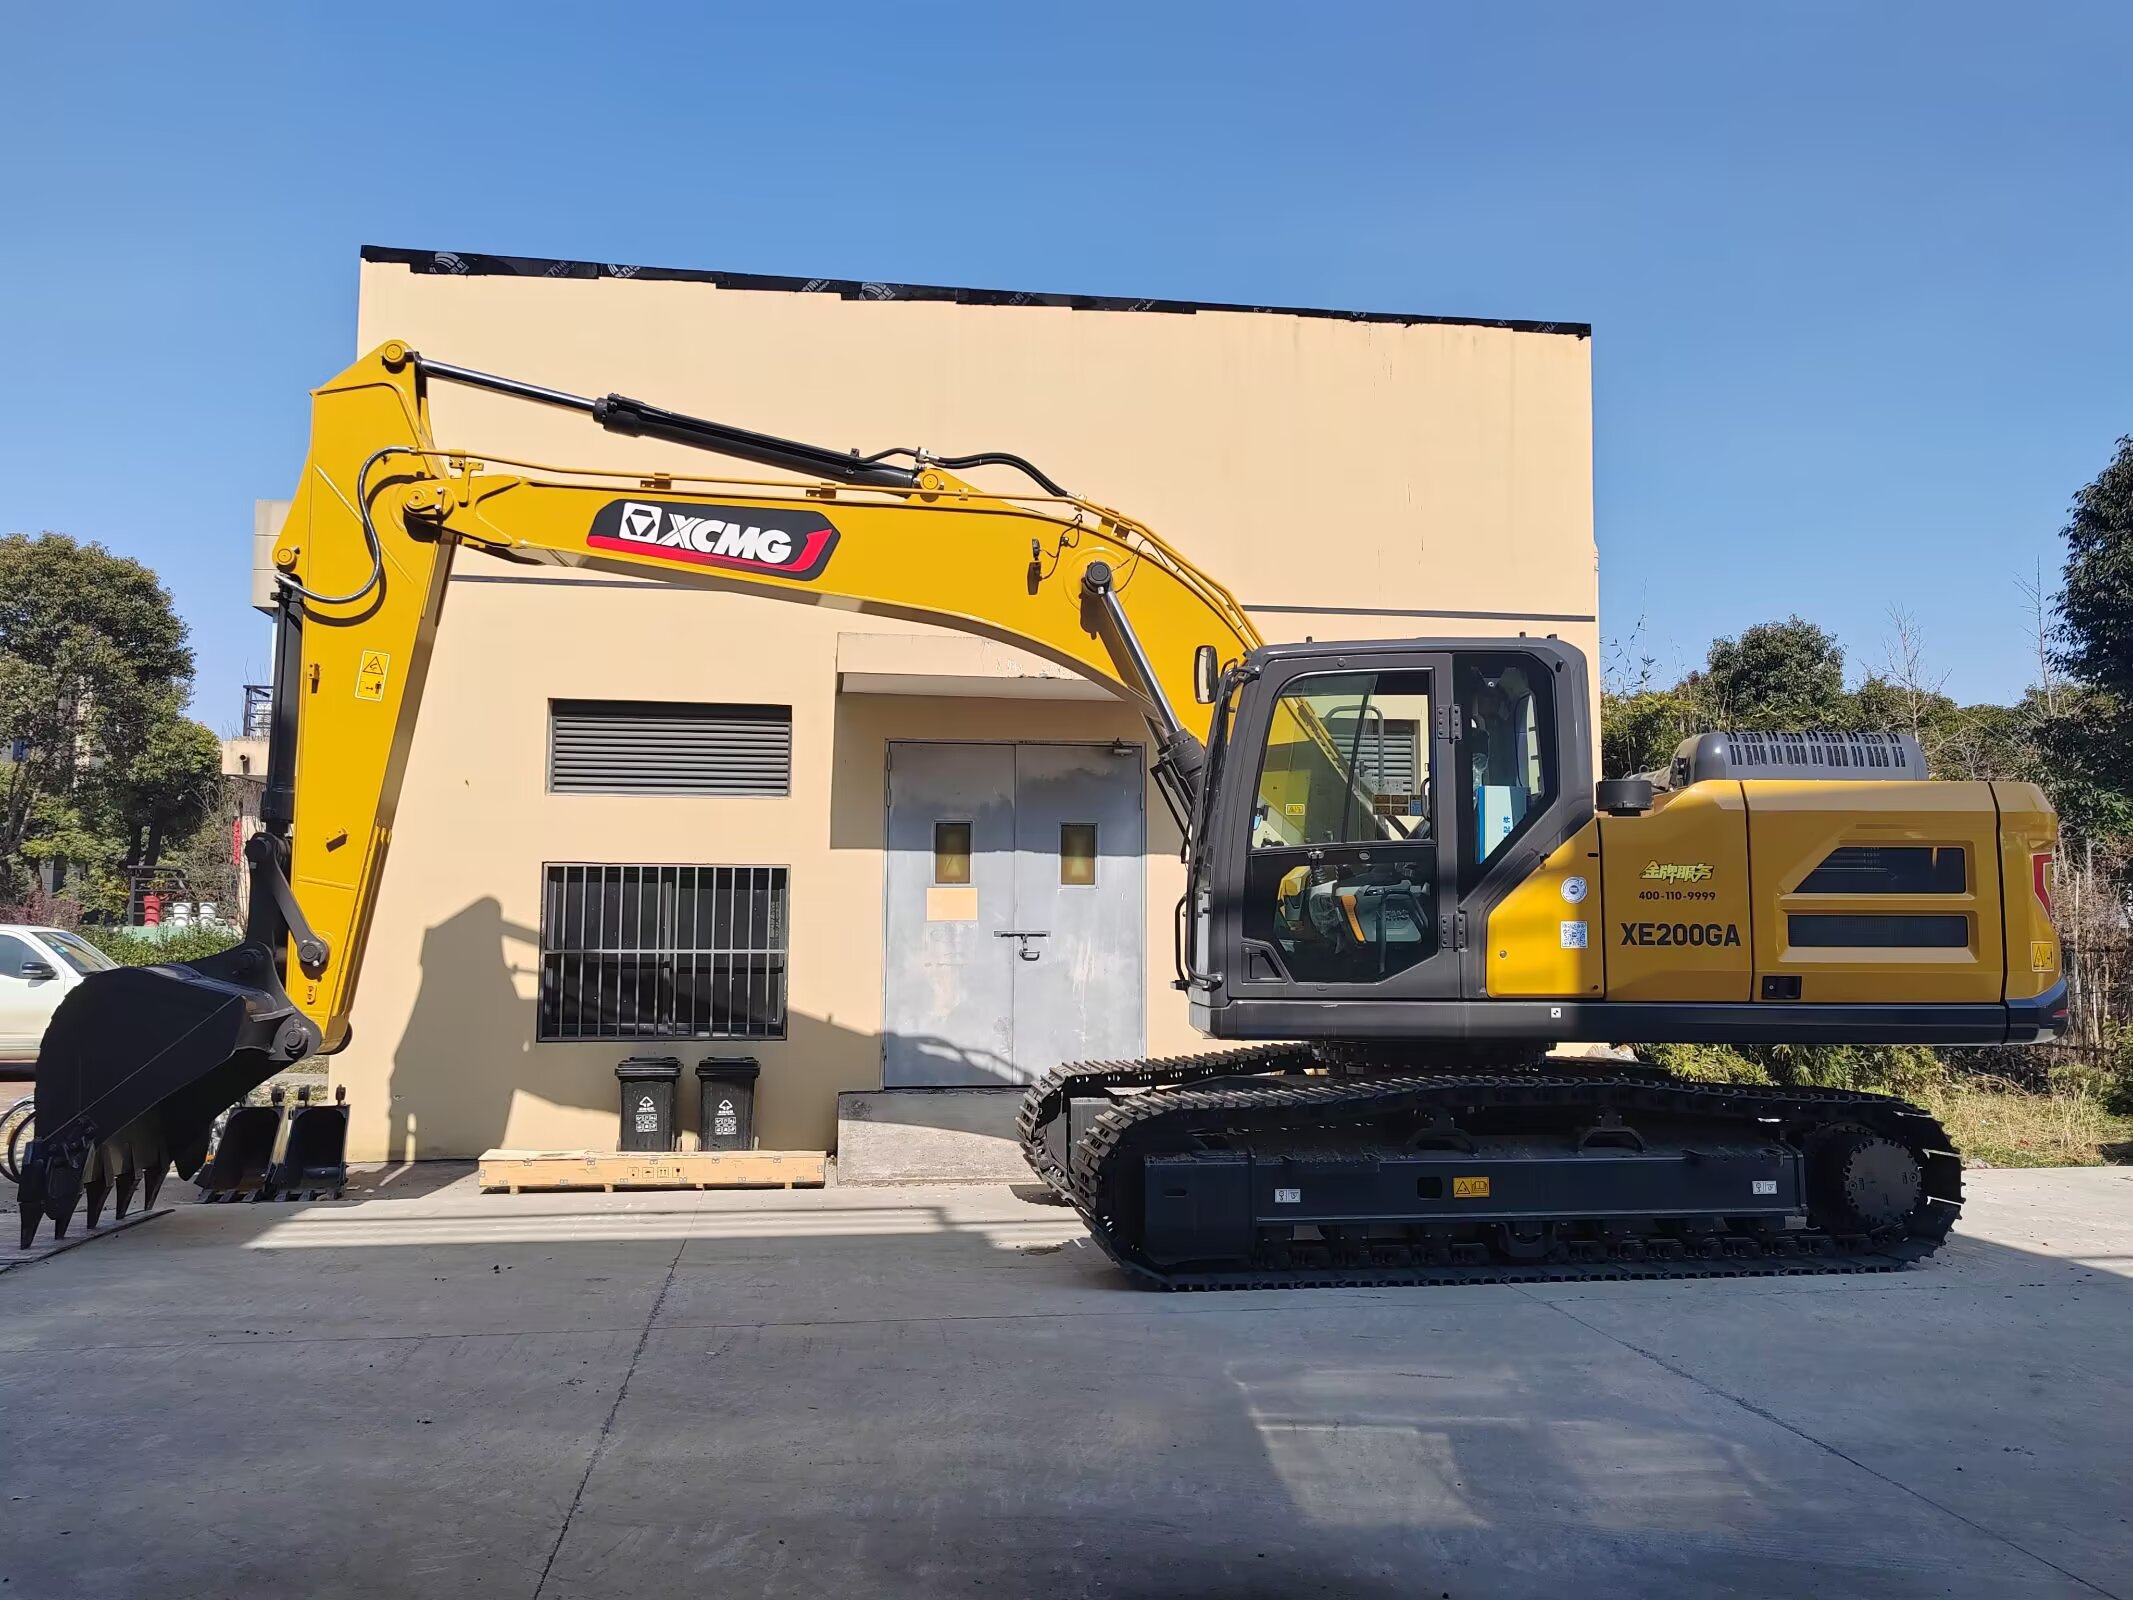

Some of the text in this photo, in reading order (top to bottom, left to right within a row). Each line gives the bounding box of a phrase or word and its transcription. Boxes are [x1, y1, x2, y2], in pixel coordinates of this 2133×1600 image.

[656, 513, 792, 564] XCMG
[1640, 860, 1714, 885] 金牌服务
[1639, 891, 1716, 900] 400-110-9999
[1620, 923, 1741, 947] XE200GA
